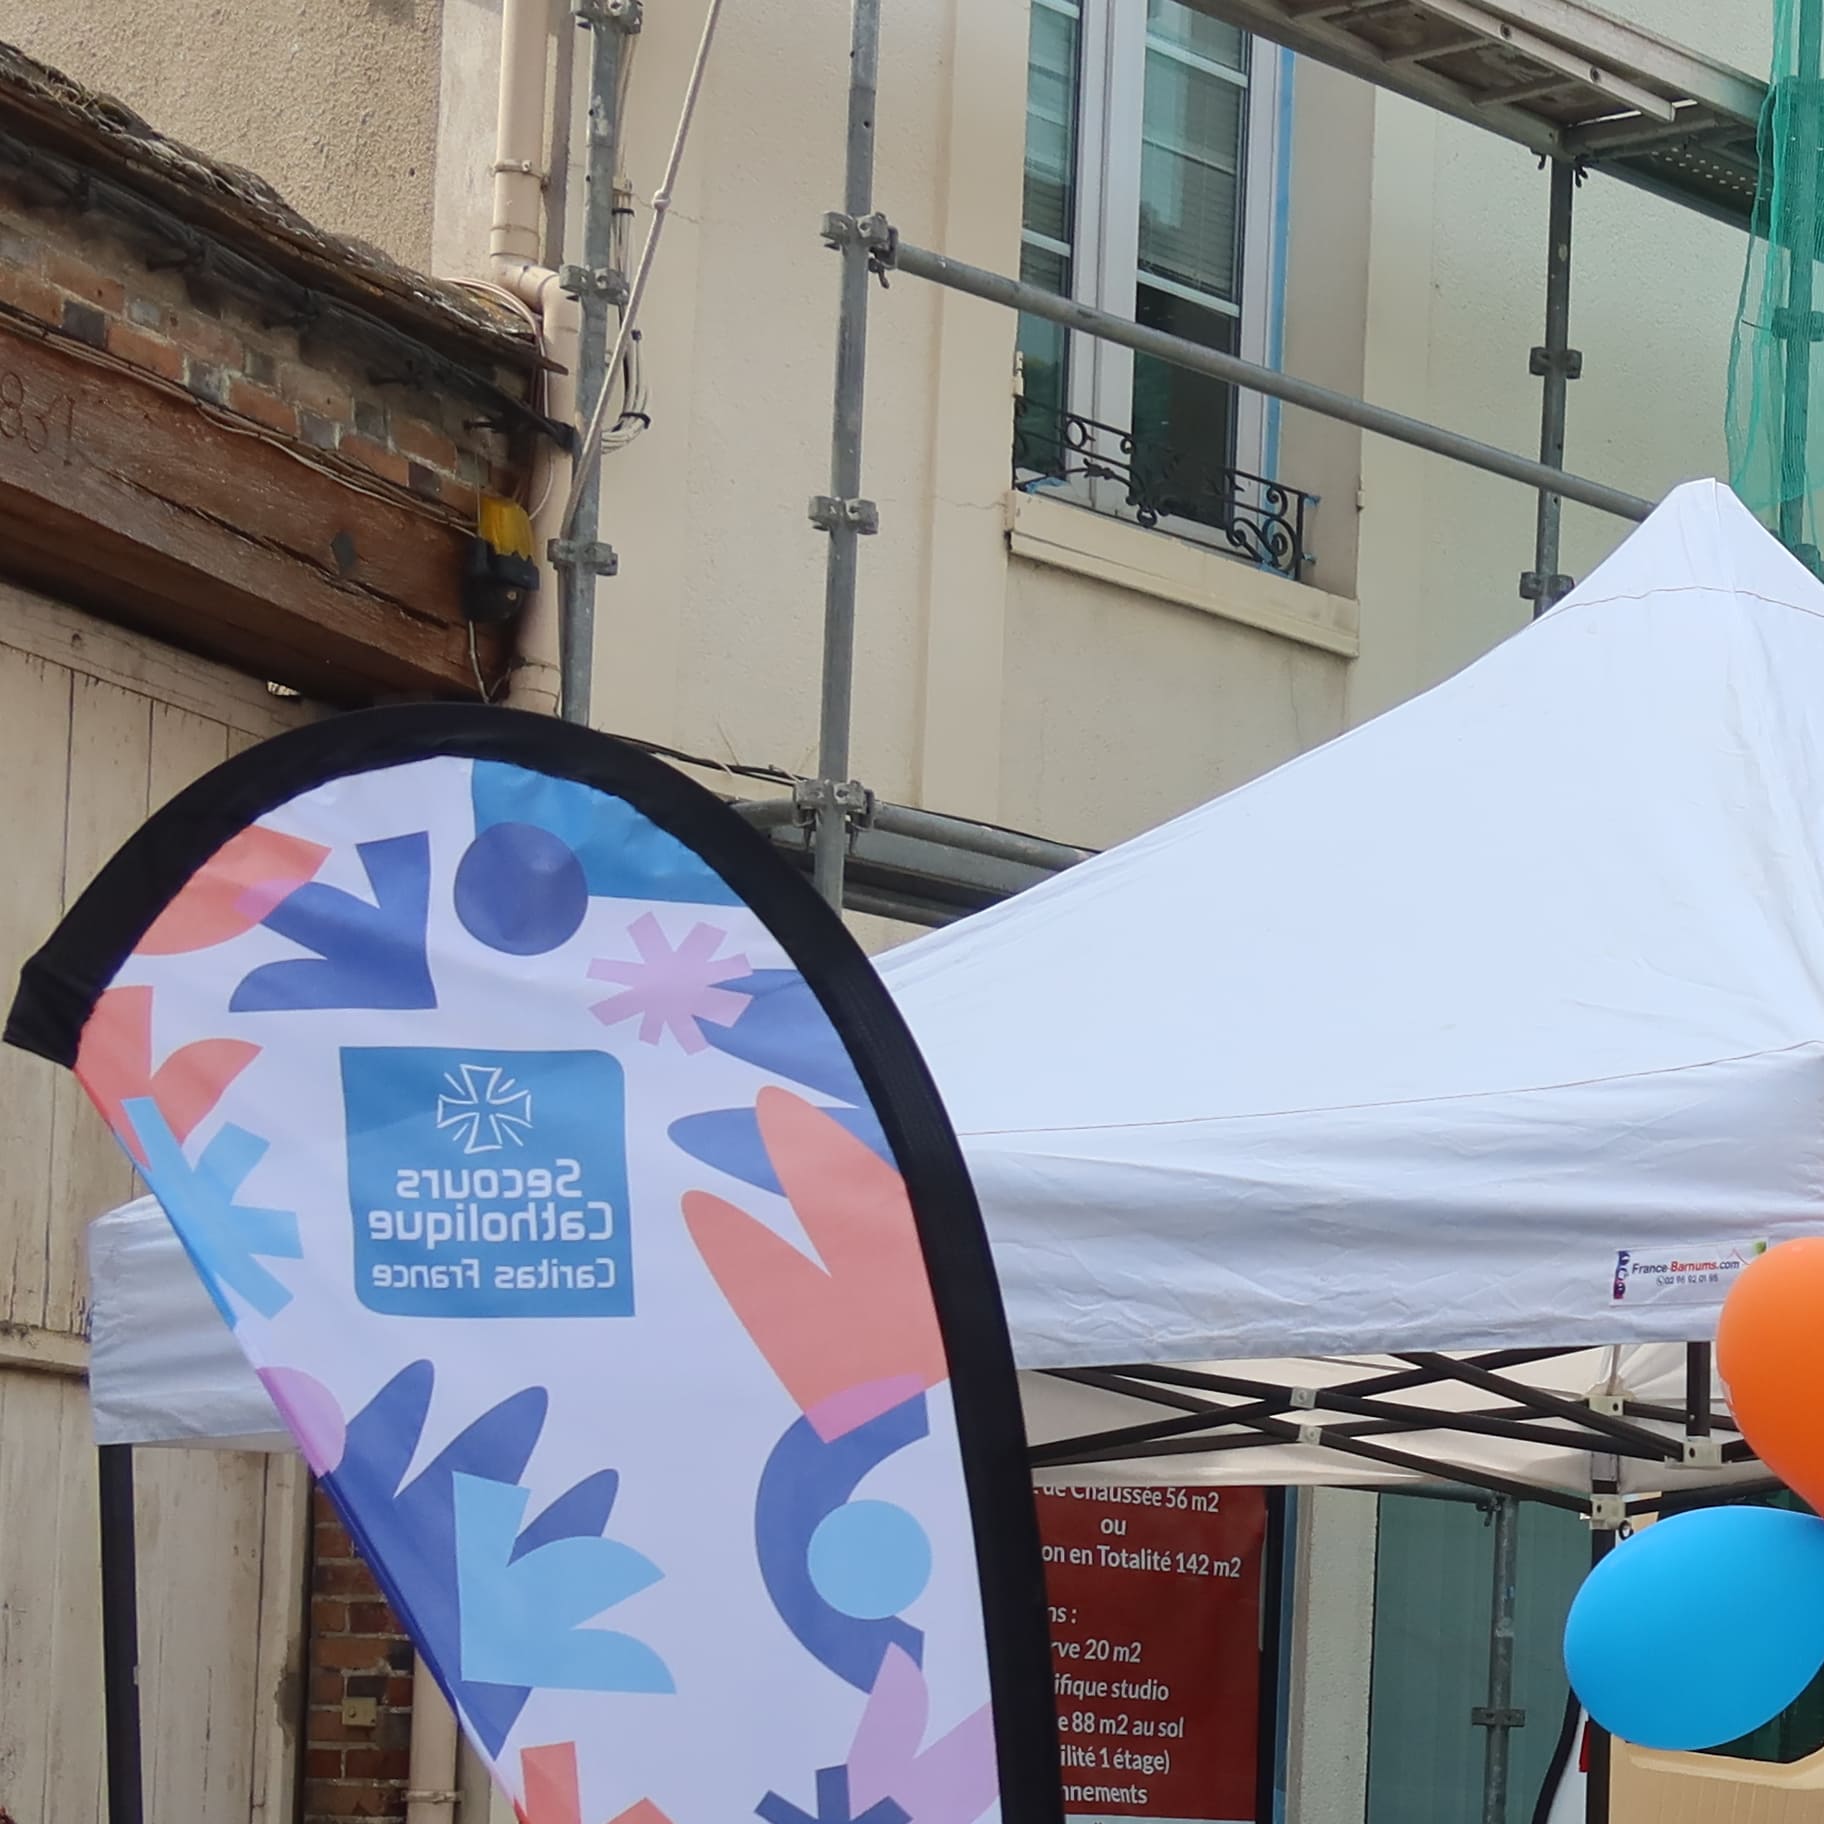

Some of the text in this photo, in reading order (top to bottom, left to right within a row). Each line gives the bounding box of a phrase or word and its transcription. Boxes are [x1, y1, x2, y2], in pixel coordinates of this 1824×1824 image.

[1071, 1486, 1163, 1506] Chaussée
[1164, 1488, 1187, 1509] 56
[1191, 1491, 1220, 1513] m2
[1100, 1517, 1127, 1535] ou
[1070, 1547, 1092, 1565] en
[1096, 1544, 1171, 1572] Totalité
[1176, 1552, 1209, 1576] 142
[1213, 1557, 1242, 1578] m2
[1084, 1638, 1110, 1660] 20
[1113, 1641, 1142, 1663] m2
[1111, 1678, 1169, 1700] studio
[1071, 1711, 1095, 1732] 88
[1100, 1714, 1128, 1735] m2
[1132, 1720, 1154, 1736] au
[1158, 1716, 1184, 1738] sol
[1113, 1748, 1170, 1774] étage)
